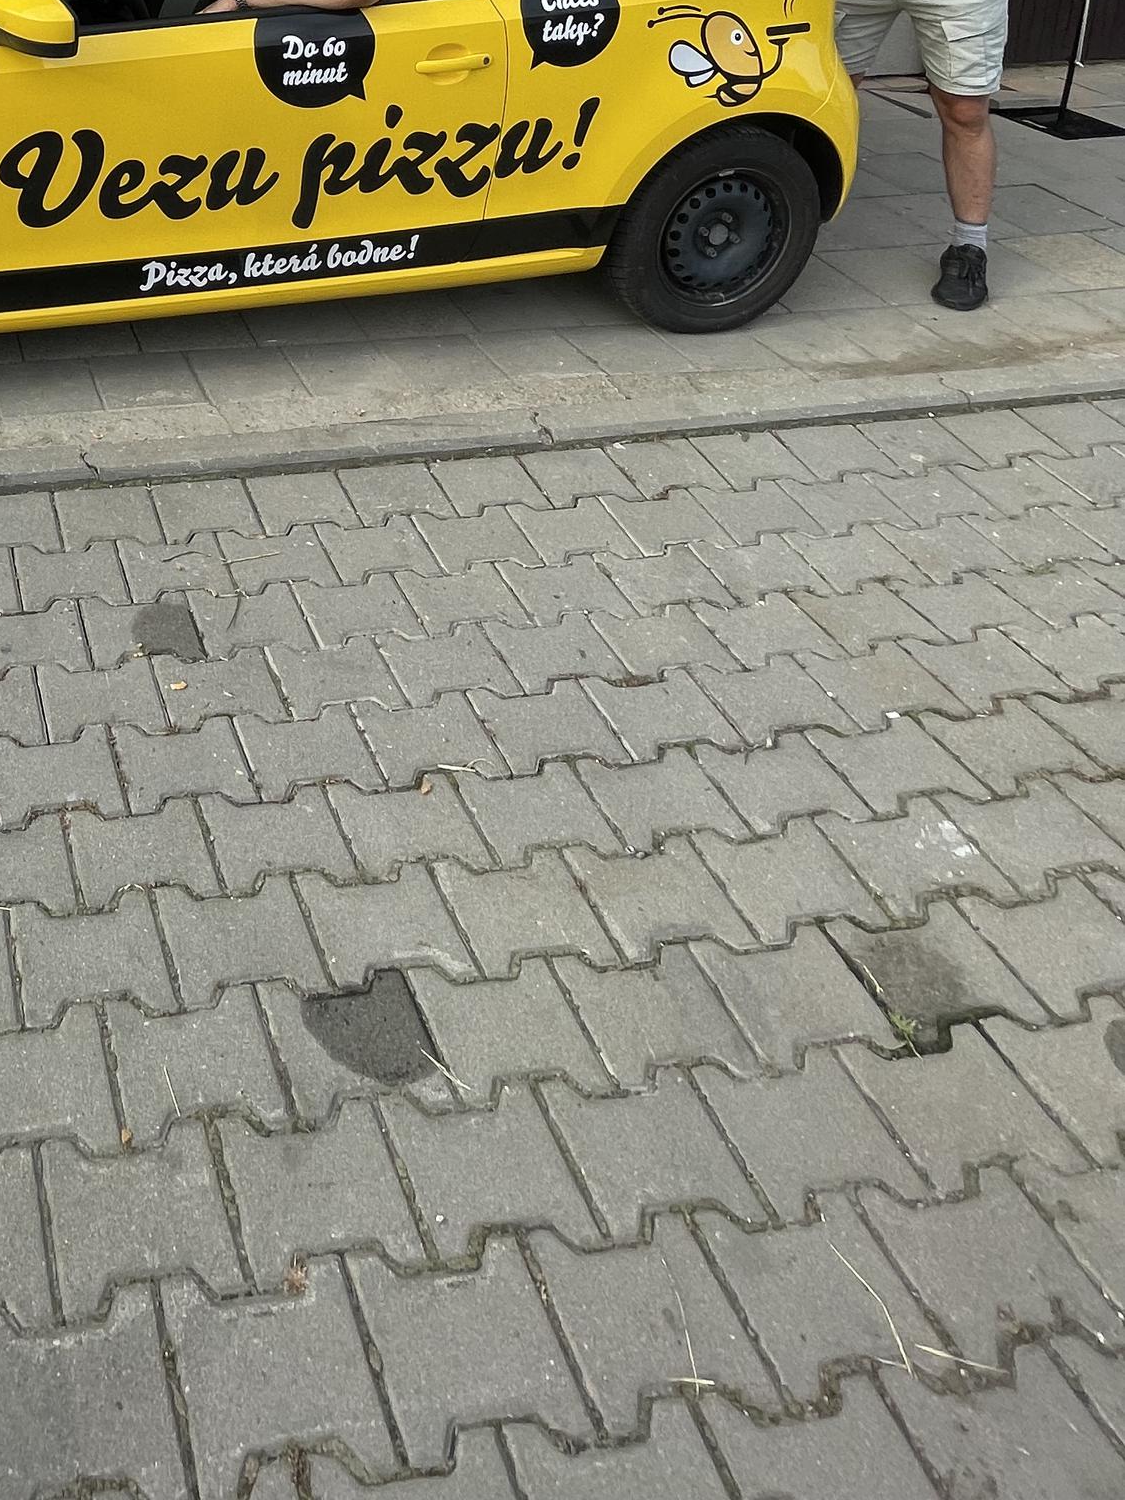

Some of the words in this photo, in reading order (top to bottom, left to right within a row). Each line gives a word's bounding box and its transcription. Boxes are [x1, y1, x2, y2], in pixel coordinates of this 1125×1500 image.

[542, 13, 605, 46] taky?
[282, 34, 319, 59] Do
[322, 36, 346, 57] 60
[282, 62, 348, 86] minut
[291, 97, 600, 229] pizzu!
[140, 261, 237, 292] Pizza,
[244, 245, 321, 278] která
[326, 234, 420, 267] bodne!
